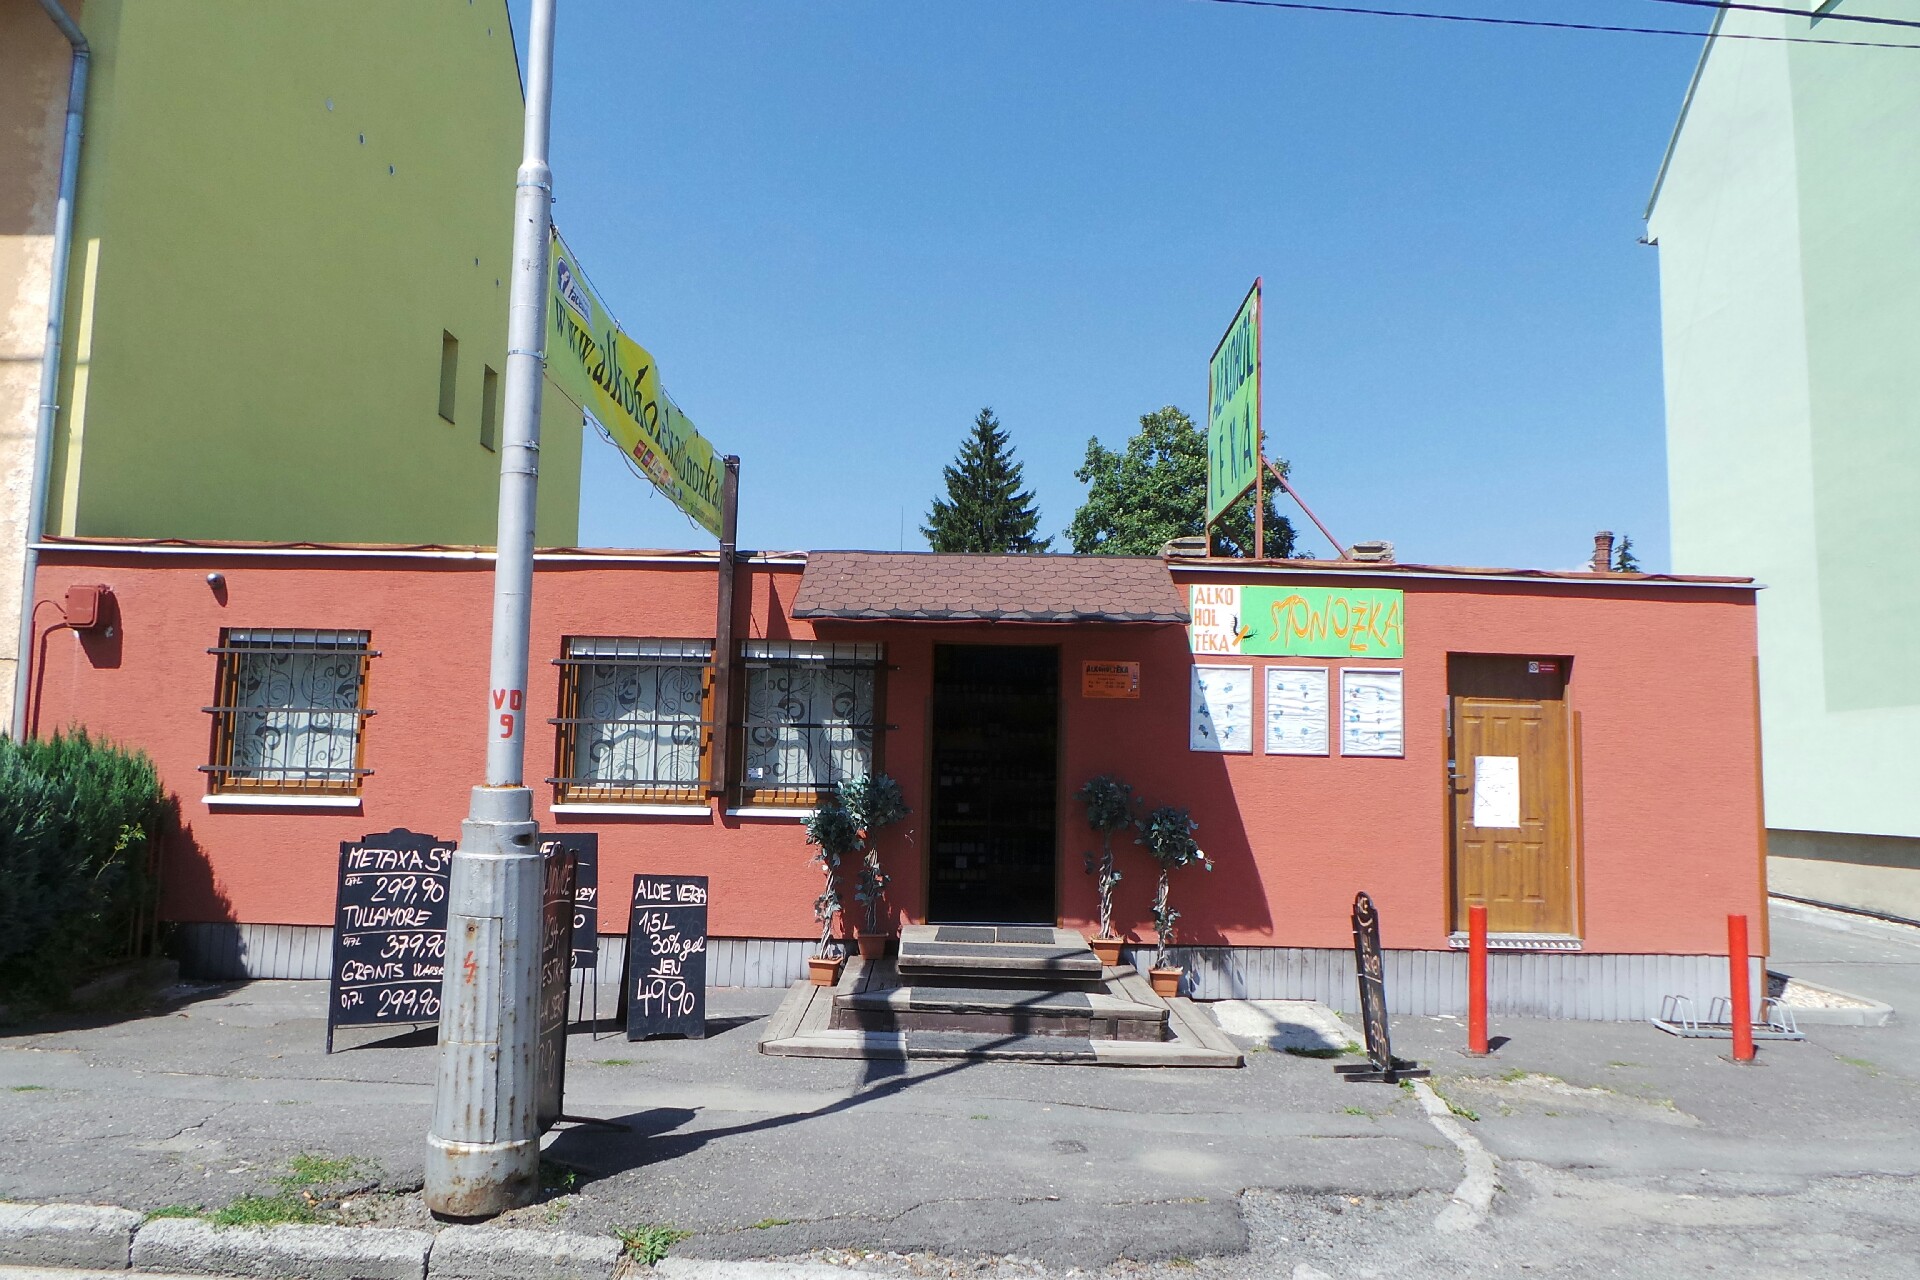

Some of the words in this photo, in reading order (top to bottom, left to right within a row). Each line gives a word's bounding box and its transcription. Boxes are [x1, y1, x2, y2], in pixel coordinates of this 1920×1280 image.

[1208, 400, 1252, 511] TÉKA
[1195, 587, 1234, 606] ALKO
[1194, 607, 1220, 627] HOL
[1270, 594, 1401, 651] STONOŽKA
[1194, 630, 1230, 652] TÉKA
[500, 714, 514, 738] 9
[347, 847, 424, 871] METAXA
[370, 876, 445, 905] 299,90
[634, 879, 672, 901] ALOE
[676, 884, 707, 904] VERA
[342, 905, 433, 929] TULLAMORE
[380, 934, 446, 959] 379,90
[650, 932, 681, 956] 30%
[679, 936, 706, 962] gel
[341, 960, 405, 982] GRANTS
[650, 957, 681, 976] JEN
[341, 990, 365, 1010] 0,7L
[376, 988, 441, 1017] 299,90
[637, 978, 695, 1019] 49,90
